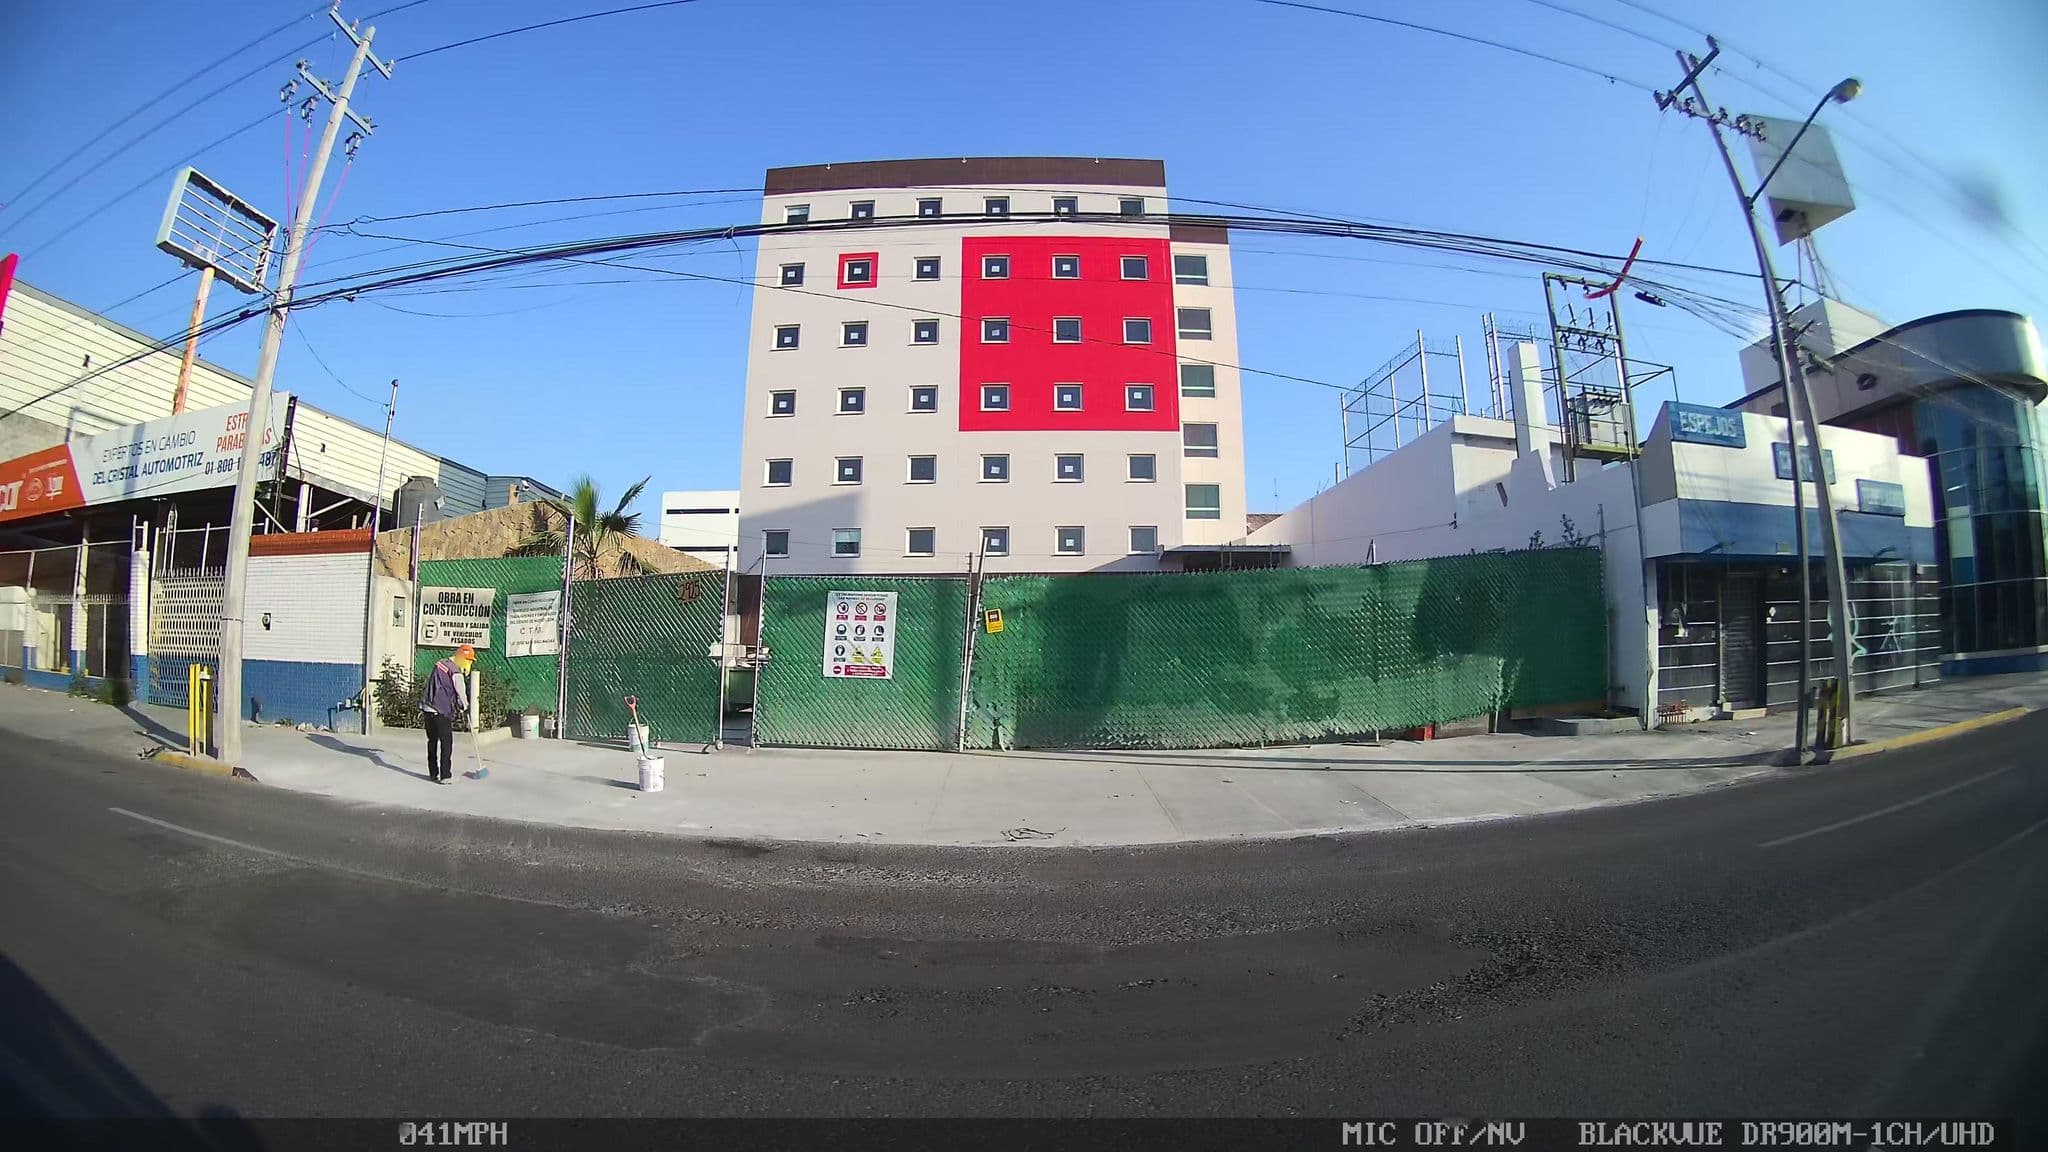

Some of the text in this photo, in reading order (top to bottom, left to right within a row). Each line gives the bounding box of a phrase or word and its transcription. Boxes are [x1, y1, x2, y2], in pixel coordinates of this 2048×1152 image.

[1679, 411, 1737, 437] ESPEJOS
[102, 430, 196, 462] EXPERTOS EN CAMBIO
[93, 452, 204, 485] DEL CRISTAL AUTOMOTRIZ
[438, 591, 475, 605] OBRA EN
[422, 603, 491, 618] CONSTRUCCIÓN
[440, 621, 465, 629] ENTRADA
[450, 637, 476, 645] PESADOS
